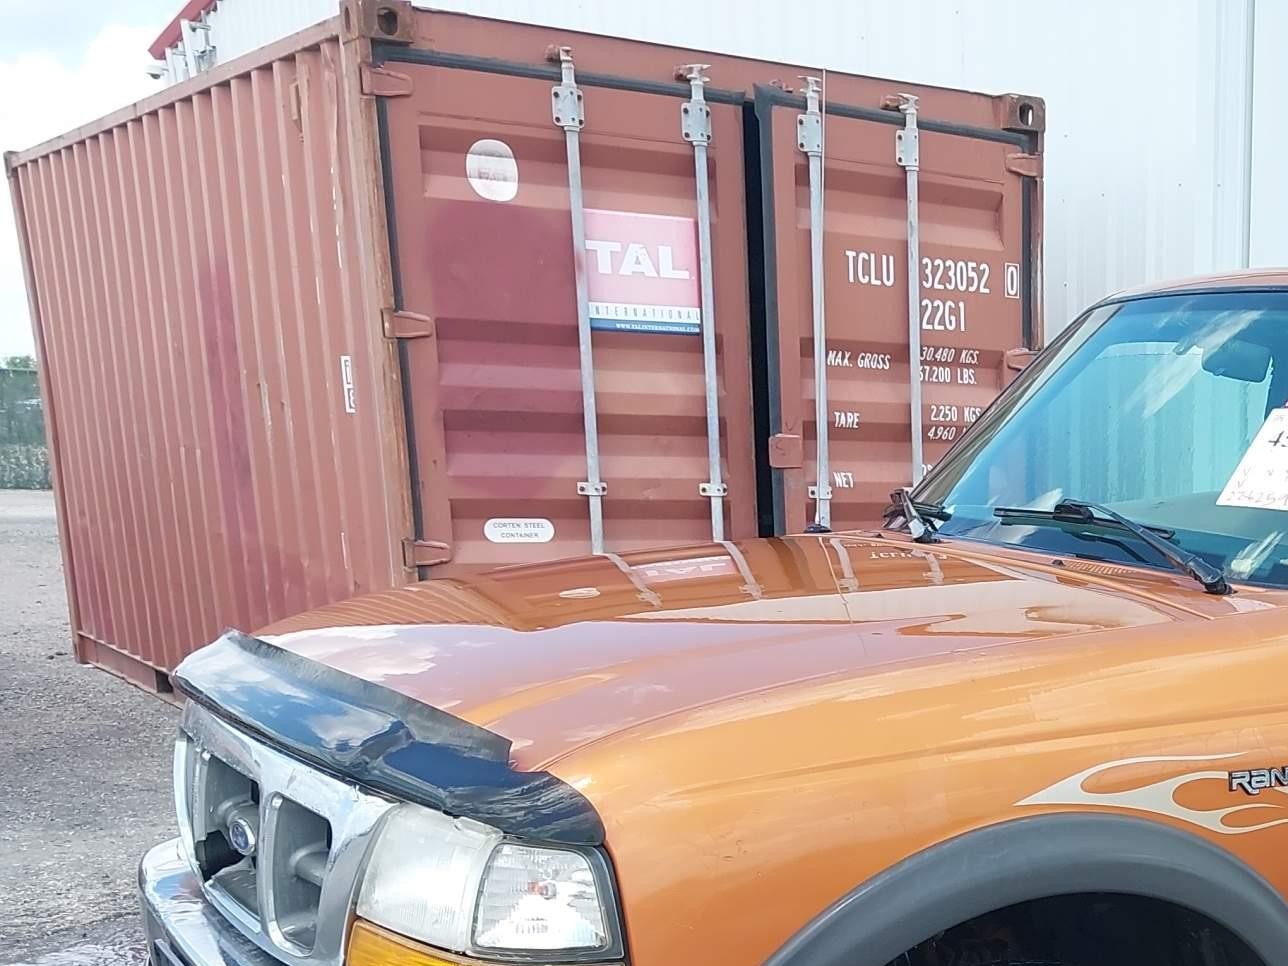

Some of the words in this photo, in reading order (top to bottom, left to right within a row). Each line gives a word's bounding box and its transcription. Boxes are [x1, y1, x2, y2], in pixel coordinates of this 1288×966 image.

[584, 239, 690, 280] TAL
[845, 250, 895, 287] TCLU
[921, 257, 990, 294] 323052
[594, 304, 700, 321] NTERNATIONAL
[921, 299, 966, 332] 22G1
[827, 350, 853, 368] MAX.
[857, 352, 891, 370] GROSS
[957, 368, 978, 385] LBS.
[834, 411, 860, 429] TARE
[930, 405, 957, 422] 2.250
[927, 426, 956, 440] 4.960
[833, 472, 855, 488] NET
